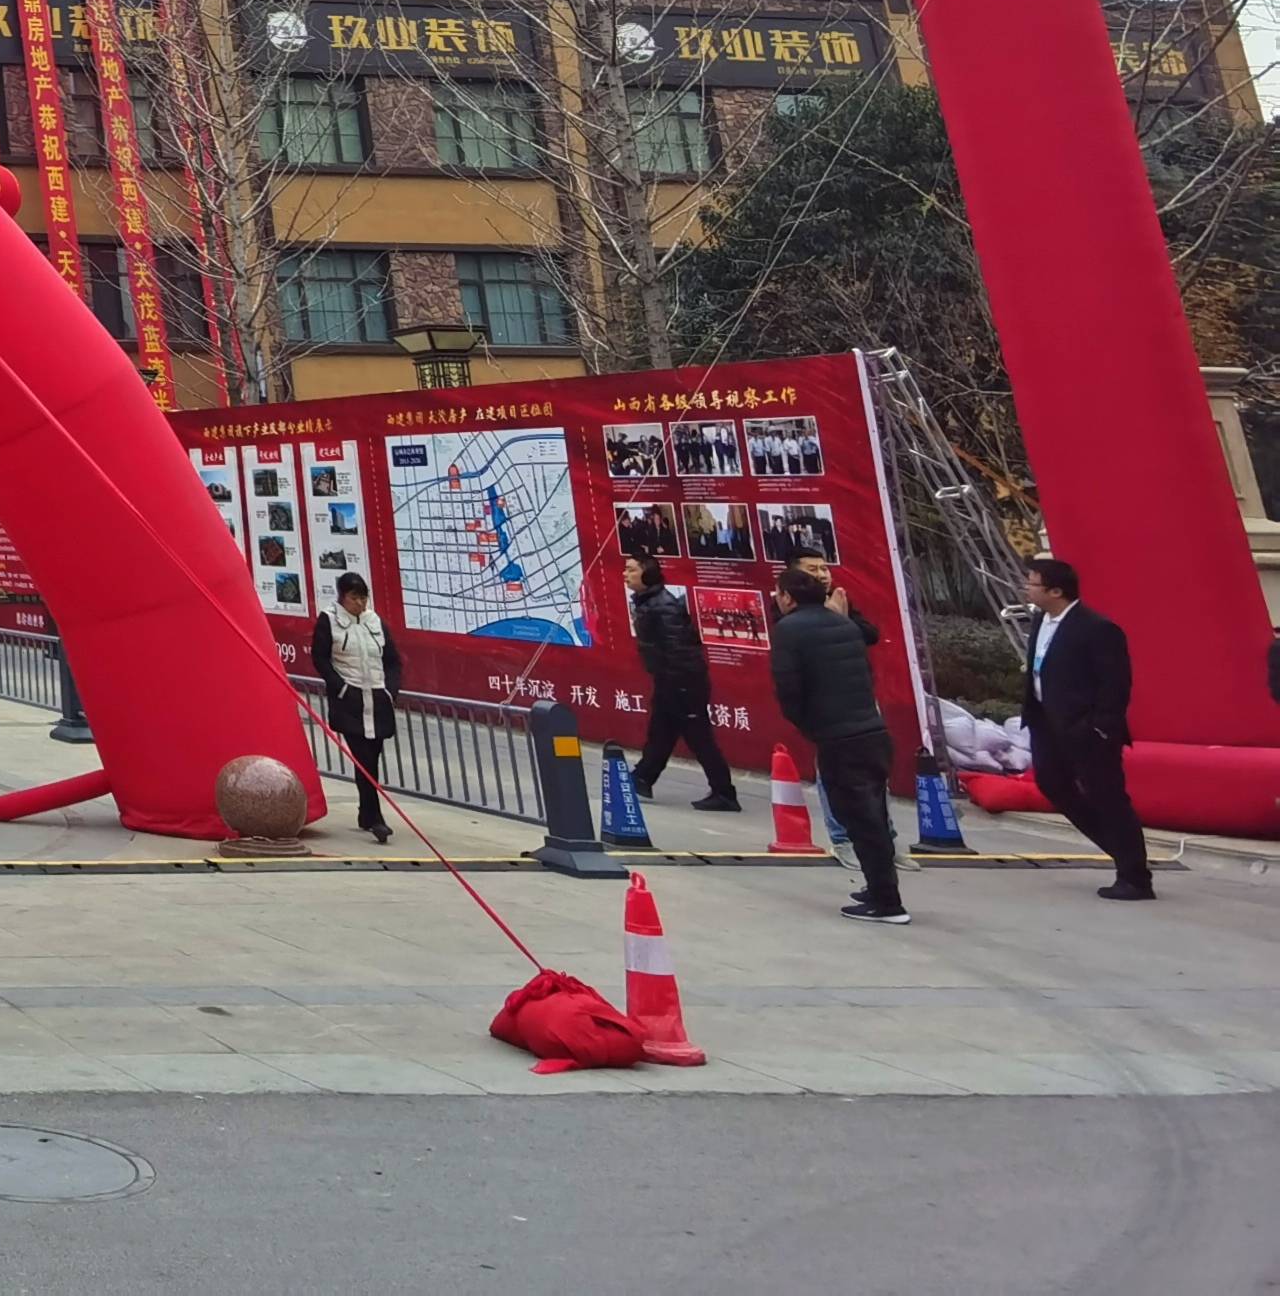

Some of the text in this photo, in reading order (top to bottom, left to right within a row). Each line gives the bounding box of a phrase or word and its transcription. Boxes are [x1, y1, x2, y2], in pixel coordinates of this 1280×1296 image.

[328, 15, 516, 54] 玖业装饰
[673, 26, 862, 66] 玖业装饰
[613, 386, 797, 413] 山西省各级领导视察工作
[488, 675, 557, 702] 四十年沉淀
[570, 685, 600, 708] 开发
[614, 688, 647, 713] 施工
